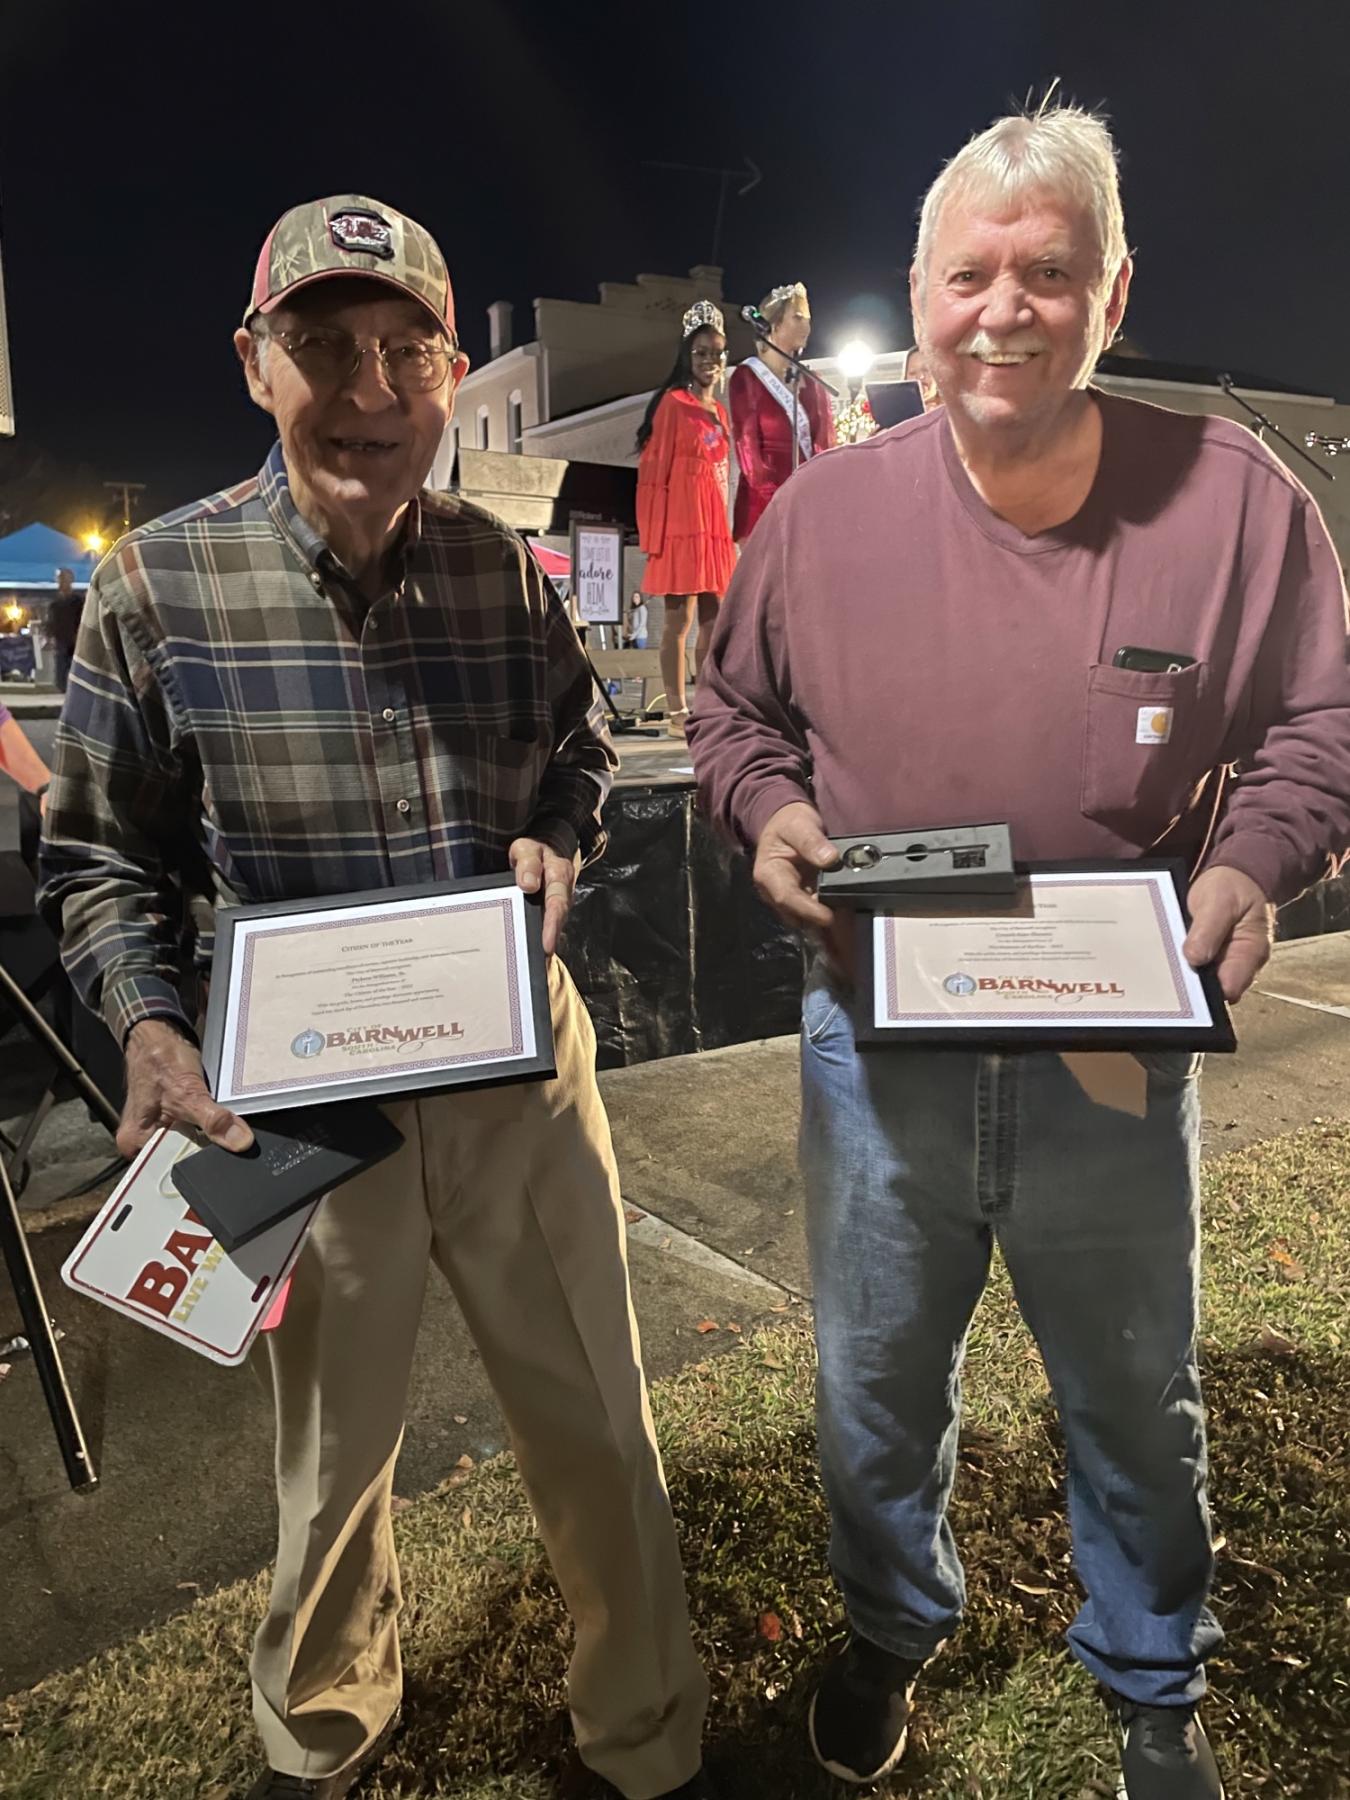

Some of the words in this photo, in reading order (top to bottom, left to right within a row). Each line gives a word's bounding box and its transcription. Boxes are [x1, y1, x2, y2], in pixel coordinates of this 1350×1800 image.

[578, 562, 614, 580] adore
[977, 977, 1126, 998] BARNWELL
[325, 1022, 465, 1050] BARNWELL
[124, 1207, 215, 1319] BA
[173, 1276, 209, 1324] LIVE
